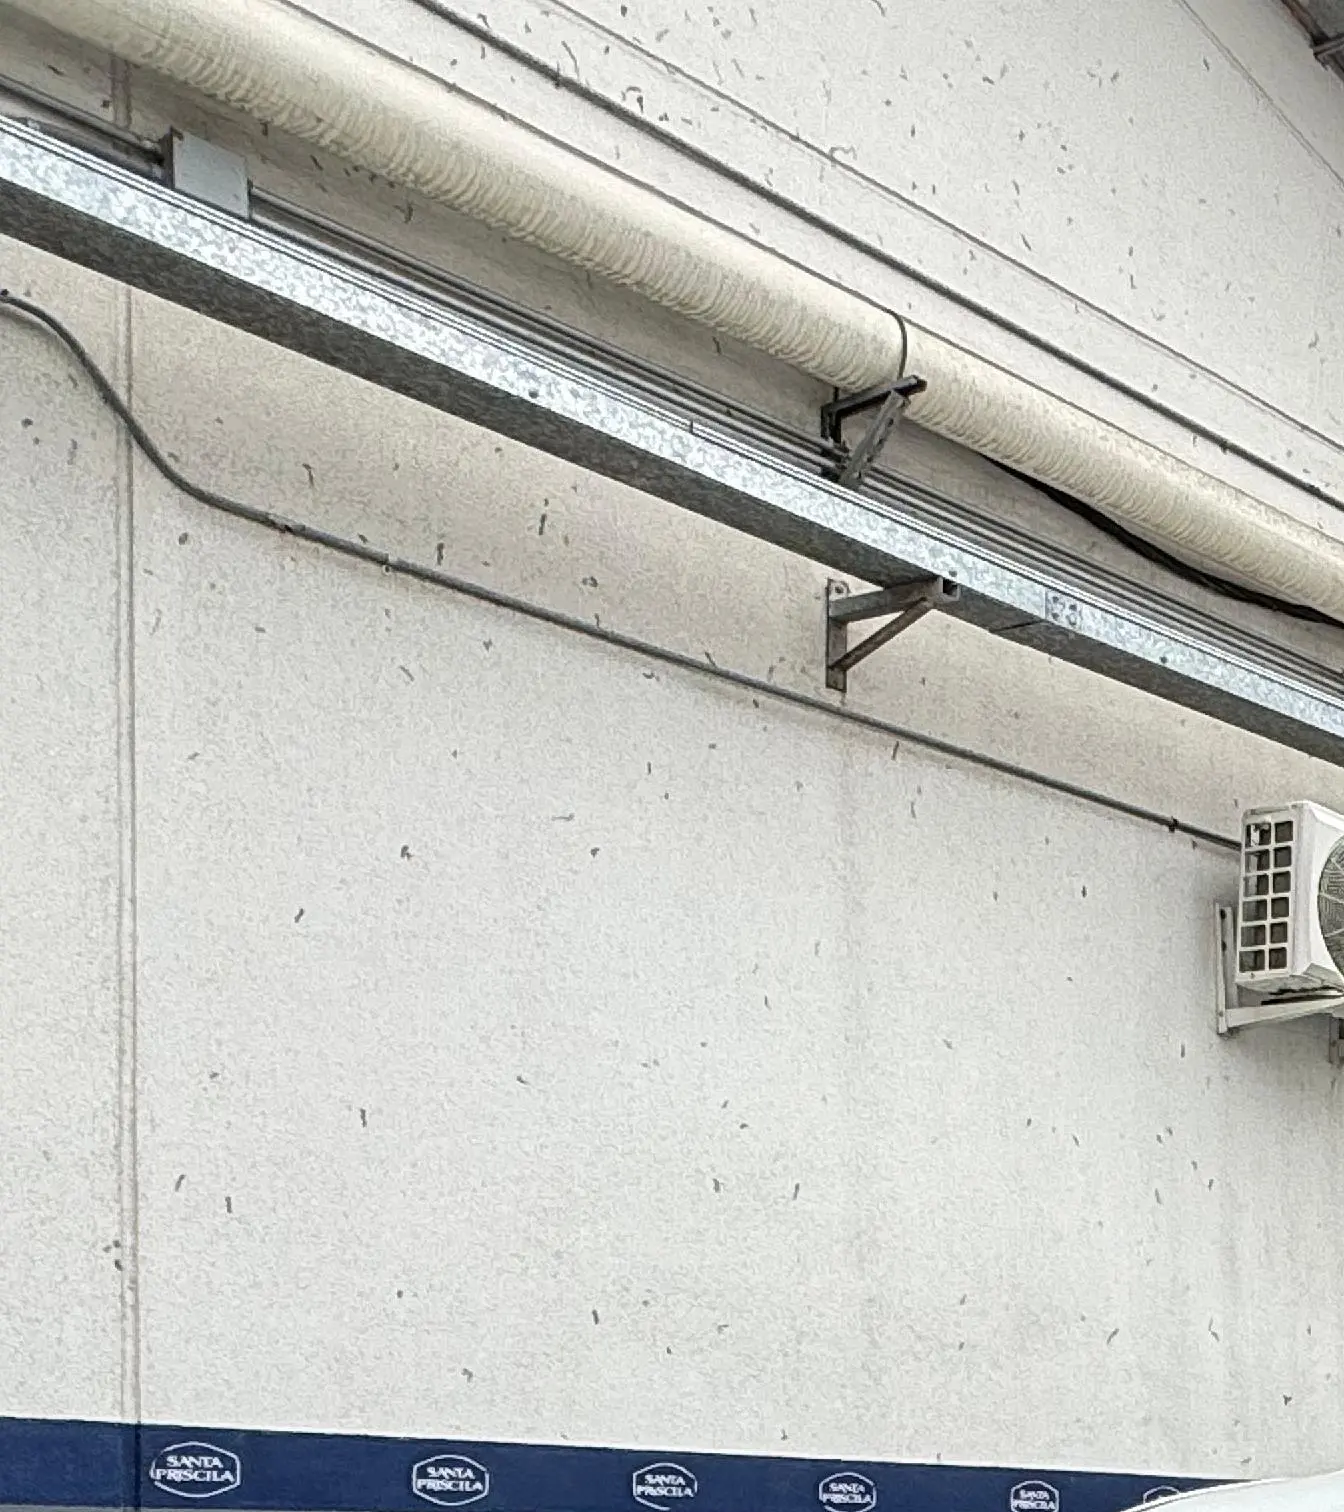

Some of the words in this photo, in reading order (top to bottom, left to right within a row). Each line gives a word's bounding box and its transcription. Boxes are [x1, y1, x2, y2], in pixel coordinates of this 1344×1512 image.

[166, 1455, 224, 1469] SANTA
[155, 1468, 235, 1483] PRISCILA
[426, 1466, 476, 1480] SANTA
